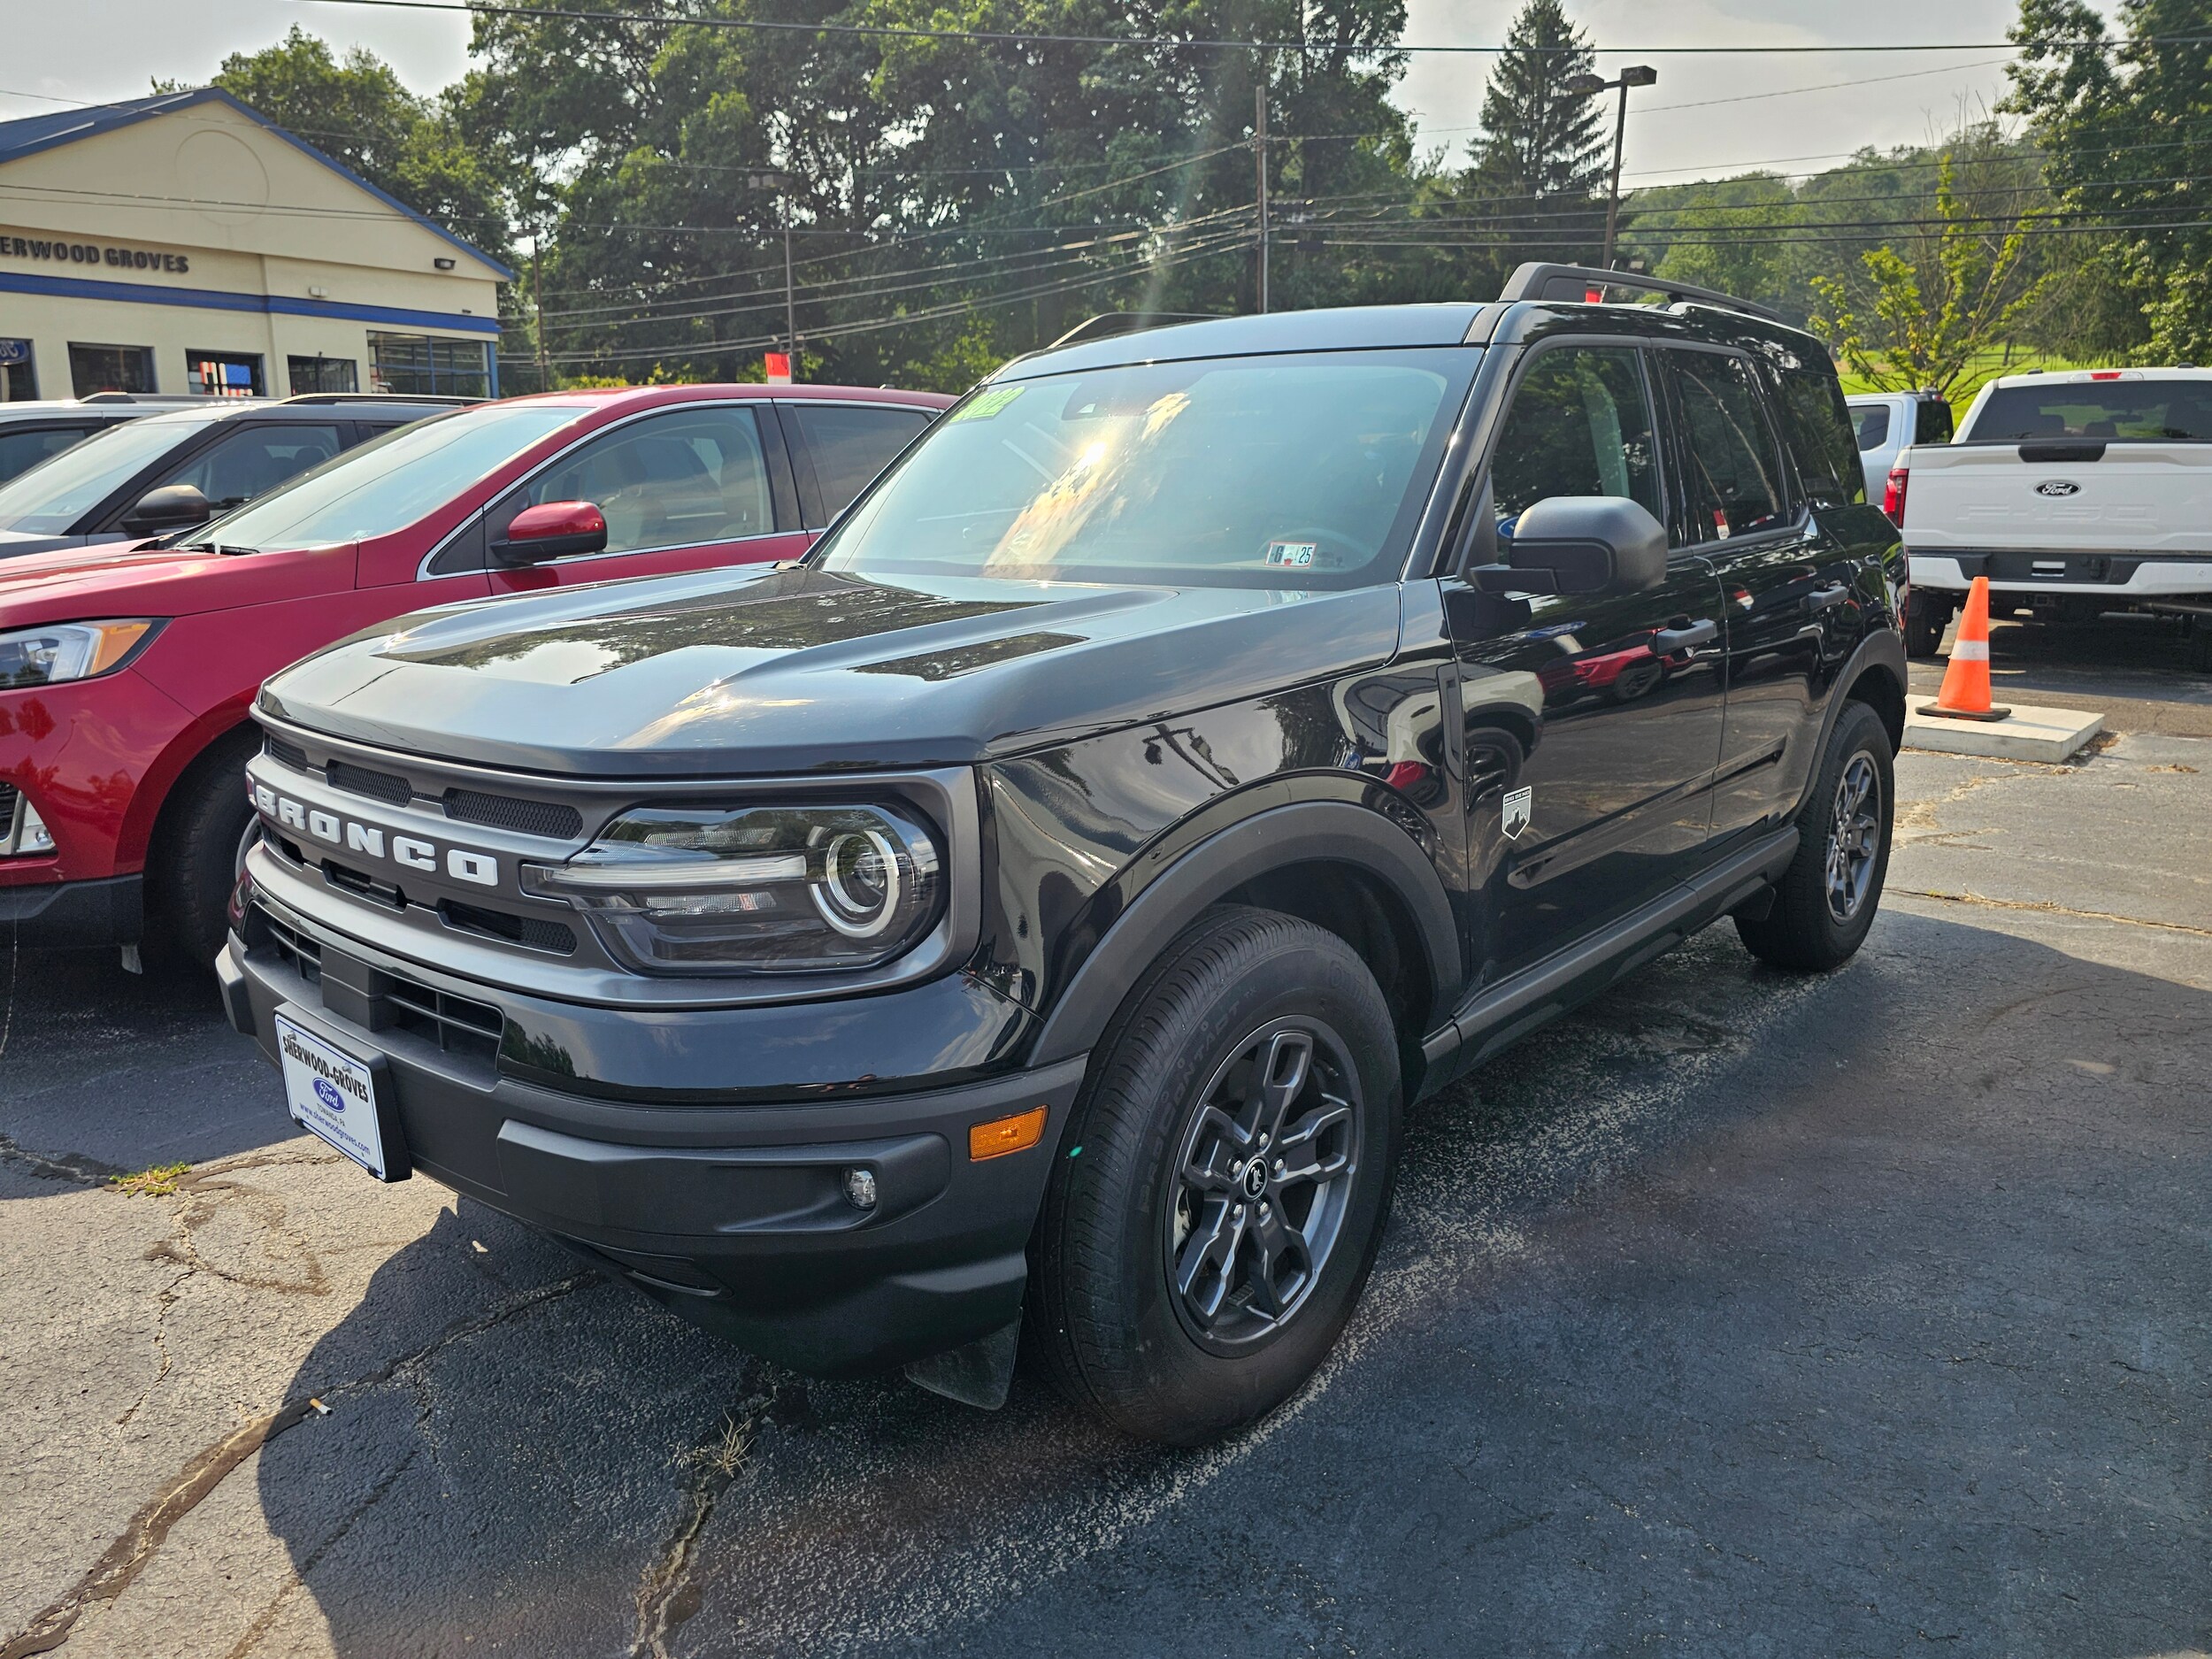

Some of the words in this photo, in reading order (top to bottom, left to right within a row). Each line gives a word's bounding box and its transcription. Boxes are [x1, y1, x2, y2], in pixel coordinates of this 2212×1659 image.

[104, 248, 189, 273] GROVES
[2042, 483, 2072, 495] Ford
[1955, 503, 2159, 522] F-150
[1274, 546, 1284, 563] 6
[1298, 547, 1313, 563] 25
[256, 784, 498, 886] BRONCO
[282, 1035, 369, 1103] SHERWOOD-GROVES
[319, 1081, 340, 1108] Ford
